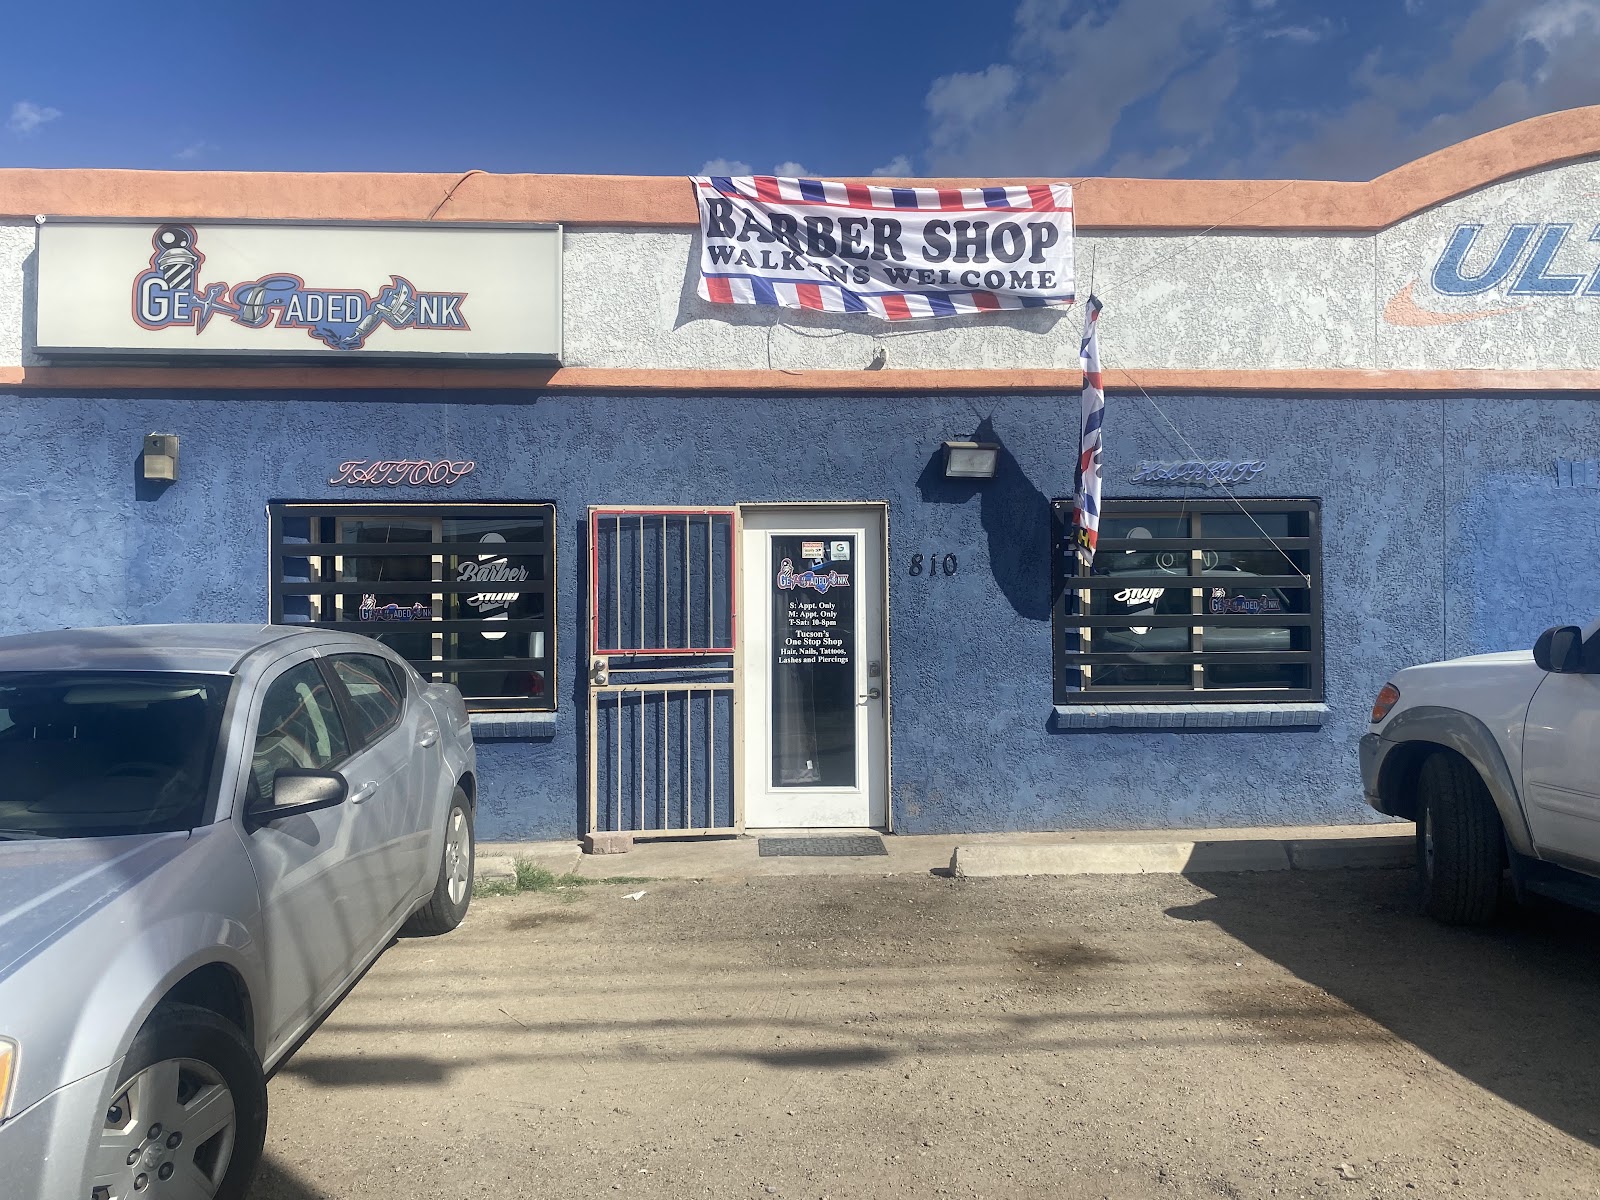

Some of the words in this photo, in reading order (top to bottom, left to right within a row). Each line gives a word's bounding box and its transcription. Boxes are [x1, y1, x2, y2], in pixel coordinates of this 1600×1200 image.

[706, 197, 907, 261] BARBER
[922, 219, 1059, 264] SHOP
[882, 267, 1058, 290] WELCOME
[330, 459, 475, 485] TATTOOS
[909, 552, 958, 577] 810
[457, 561, 529, 582] Barber
[798, 602, 818, 610] Appt.
[818, 602, 836, 610] Only
[799, 611, 819, 619] Appt.
[820, 611, 838, 619] Only
[811, 619, 837, 627] 10-8pm
[795, 630, 830, 638] Tucson's
[785, 638, 802, 646] One
[803, 638, 822, 647] Stop
[822, 638, 843, 647] Shop
[780, 648, 798, 656] Hair,
[799, 648, 819, 656] Nails,
[819, 648, 847, 656] Tattoos,
[778, 656, 802, 664] Lashes
[802, 656, 816, 664] and
[817, 656, 849, 665] Piercings
